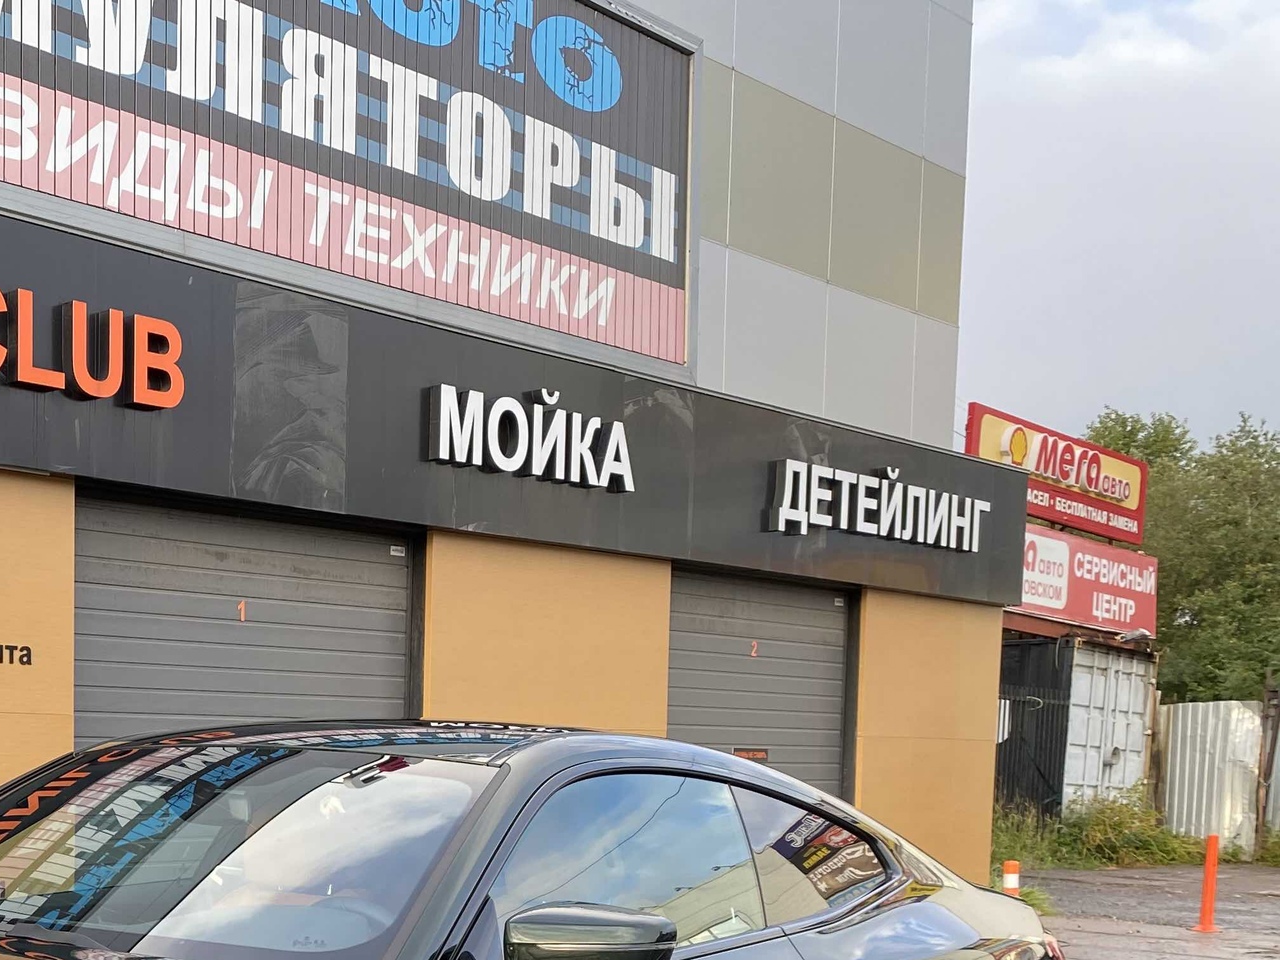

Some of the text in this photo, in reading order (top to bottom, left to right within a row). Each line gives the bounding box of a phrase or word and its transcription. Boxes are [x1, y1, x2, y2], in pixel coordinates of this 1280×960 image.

[304, 184, 617, 327] ТЕХНИКИ
[436, 383, 635, 492] МОЙКА
[777, 459, 991, 553] ДЕТЕЙЛИНГ
[1108, 512, 1139, 534] ЗАМЕНА
[1074, 551, 1156, 596] СЕРВИСНЫЙ
[1092, 591, 1136, 623] ЦЕНТР
